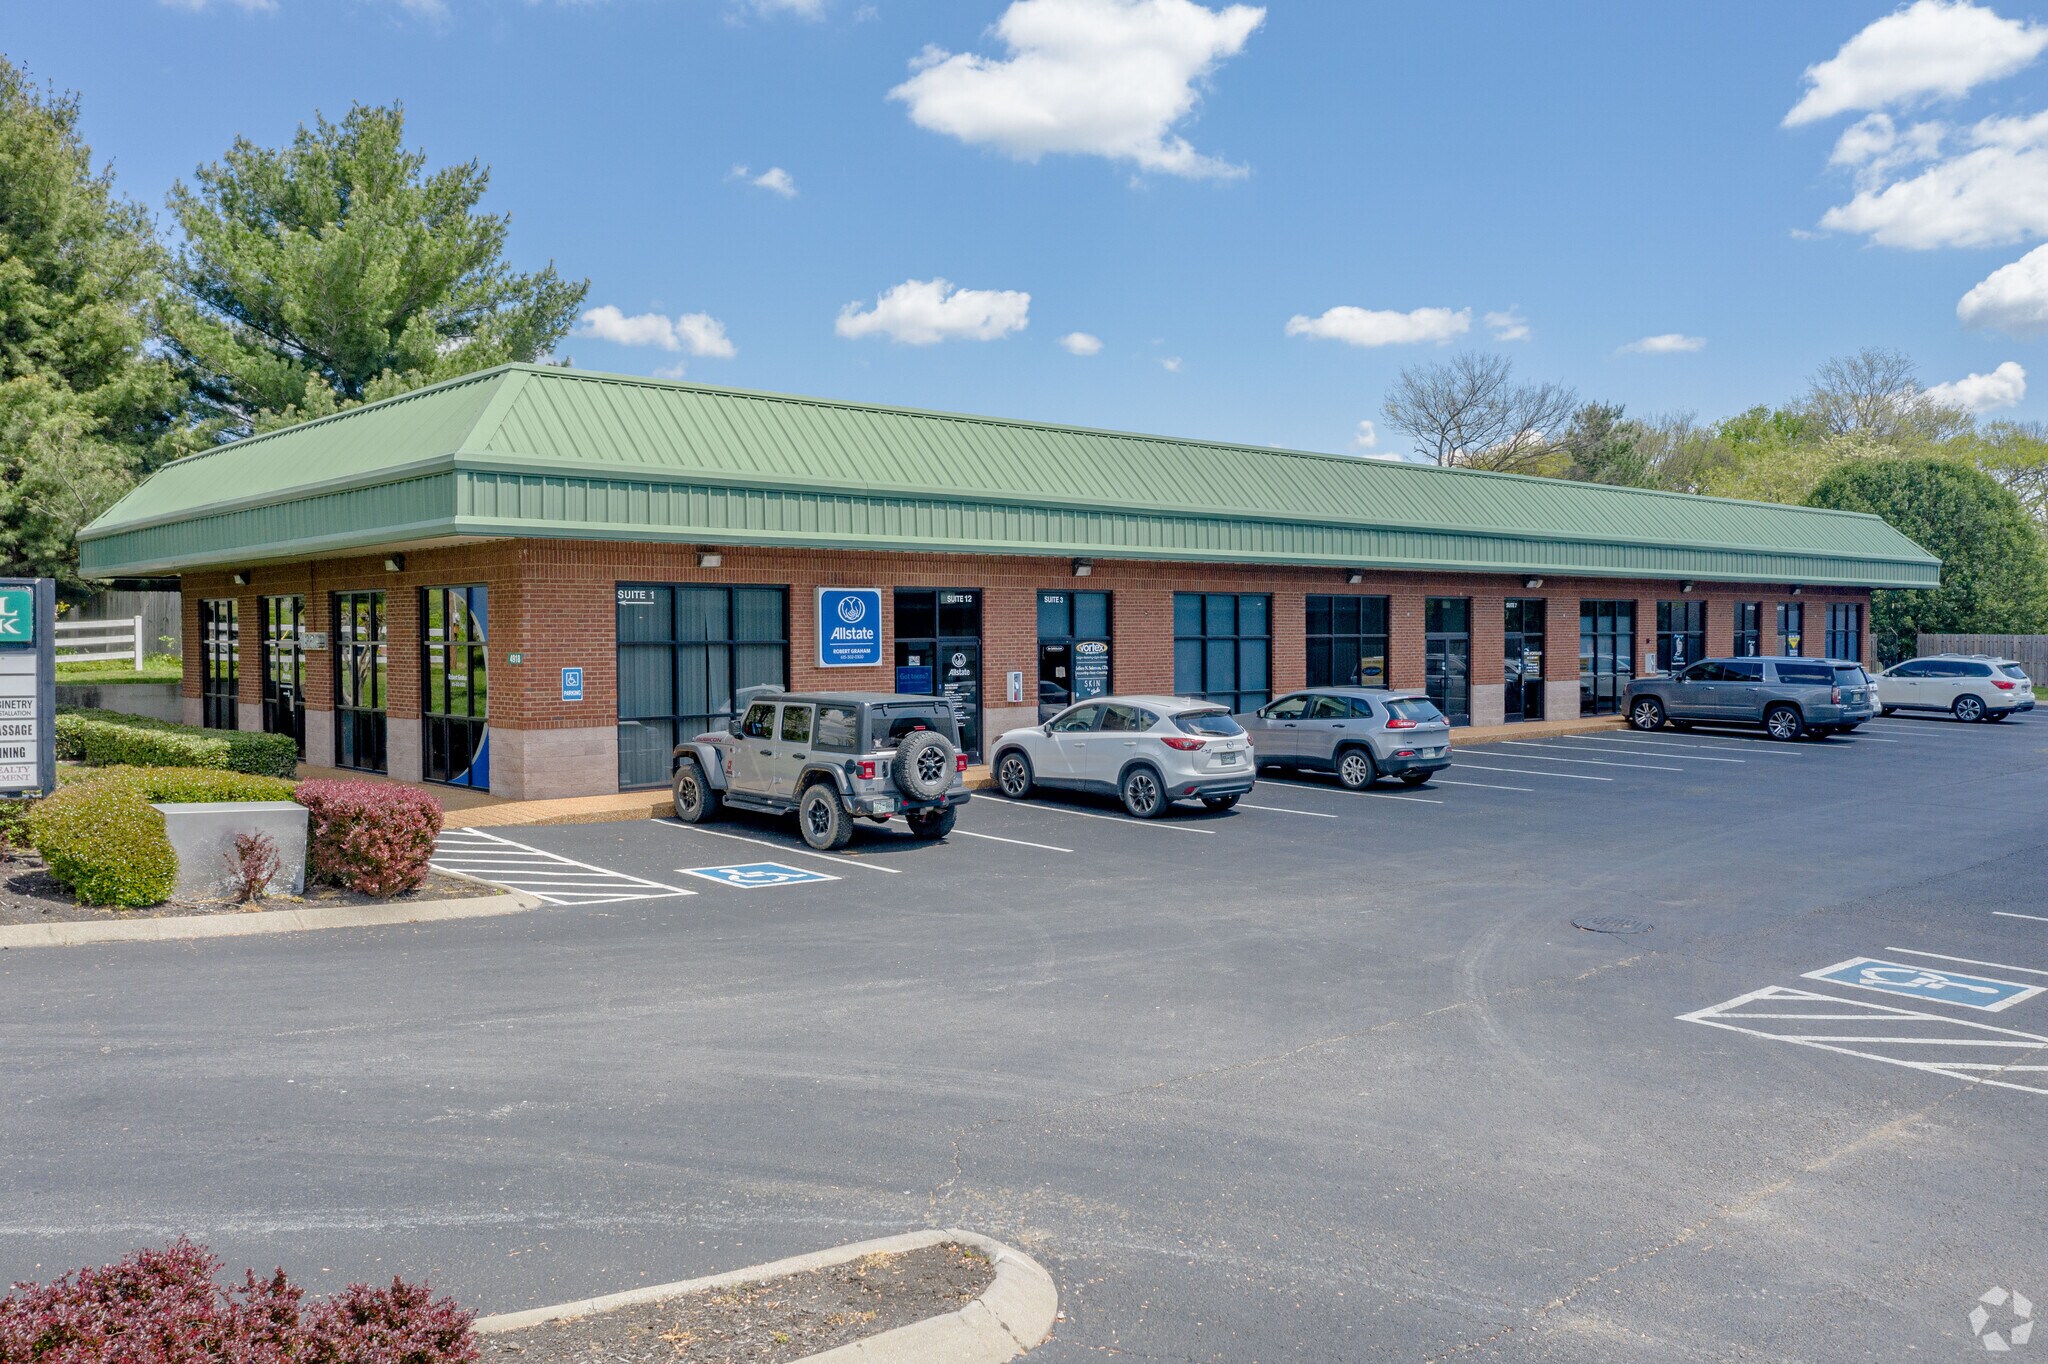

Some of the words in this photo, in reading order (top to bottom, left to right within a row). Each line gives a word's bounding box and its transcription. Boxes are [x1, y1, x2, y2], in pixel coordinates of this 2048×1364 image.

[617, 590, 646, 599] SUITE
[650, 591, 655, 599] 1
[947, 595, 963, 603] SUITE
[964, 595, 972, 603] 12
[830, 627, 874, 640] Allstate
[948, 668, 971, 676] Allstate
[1084, 680, 1101, 688] SKIN
